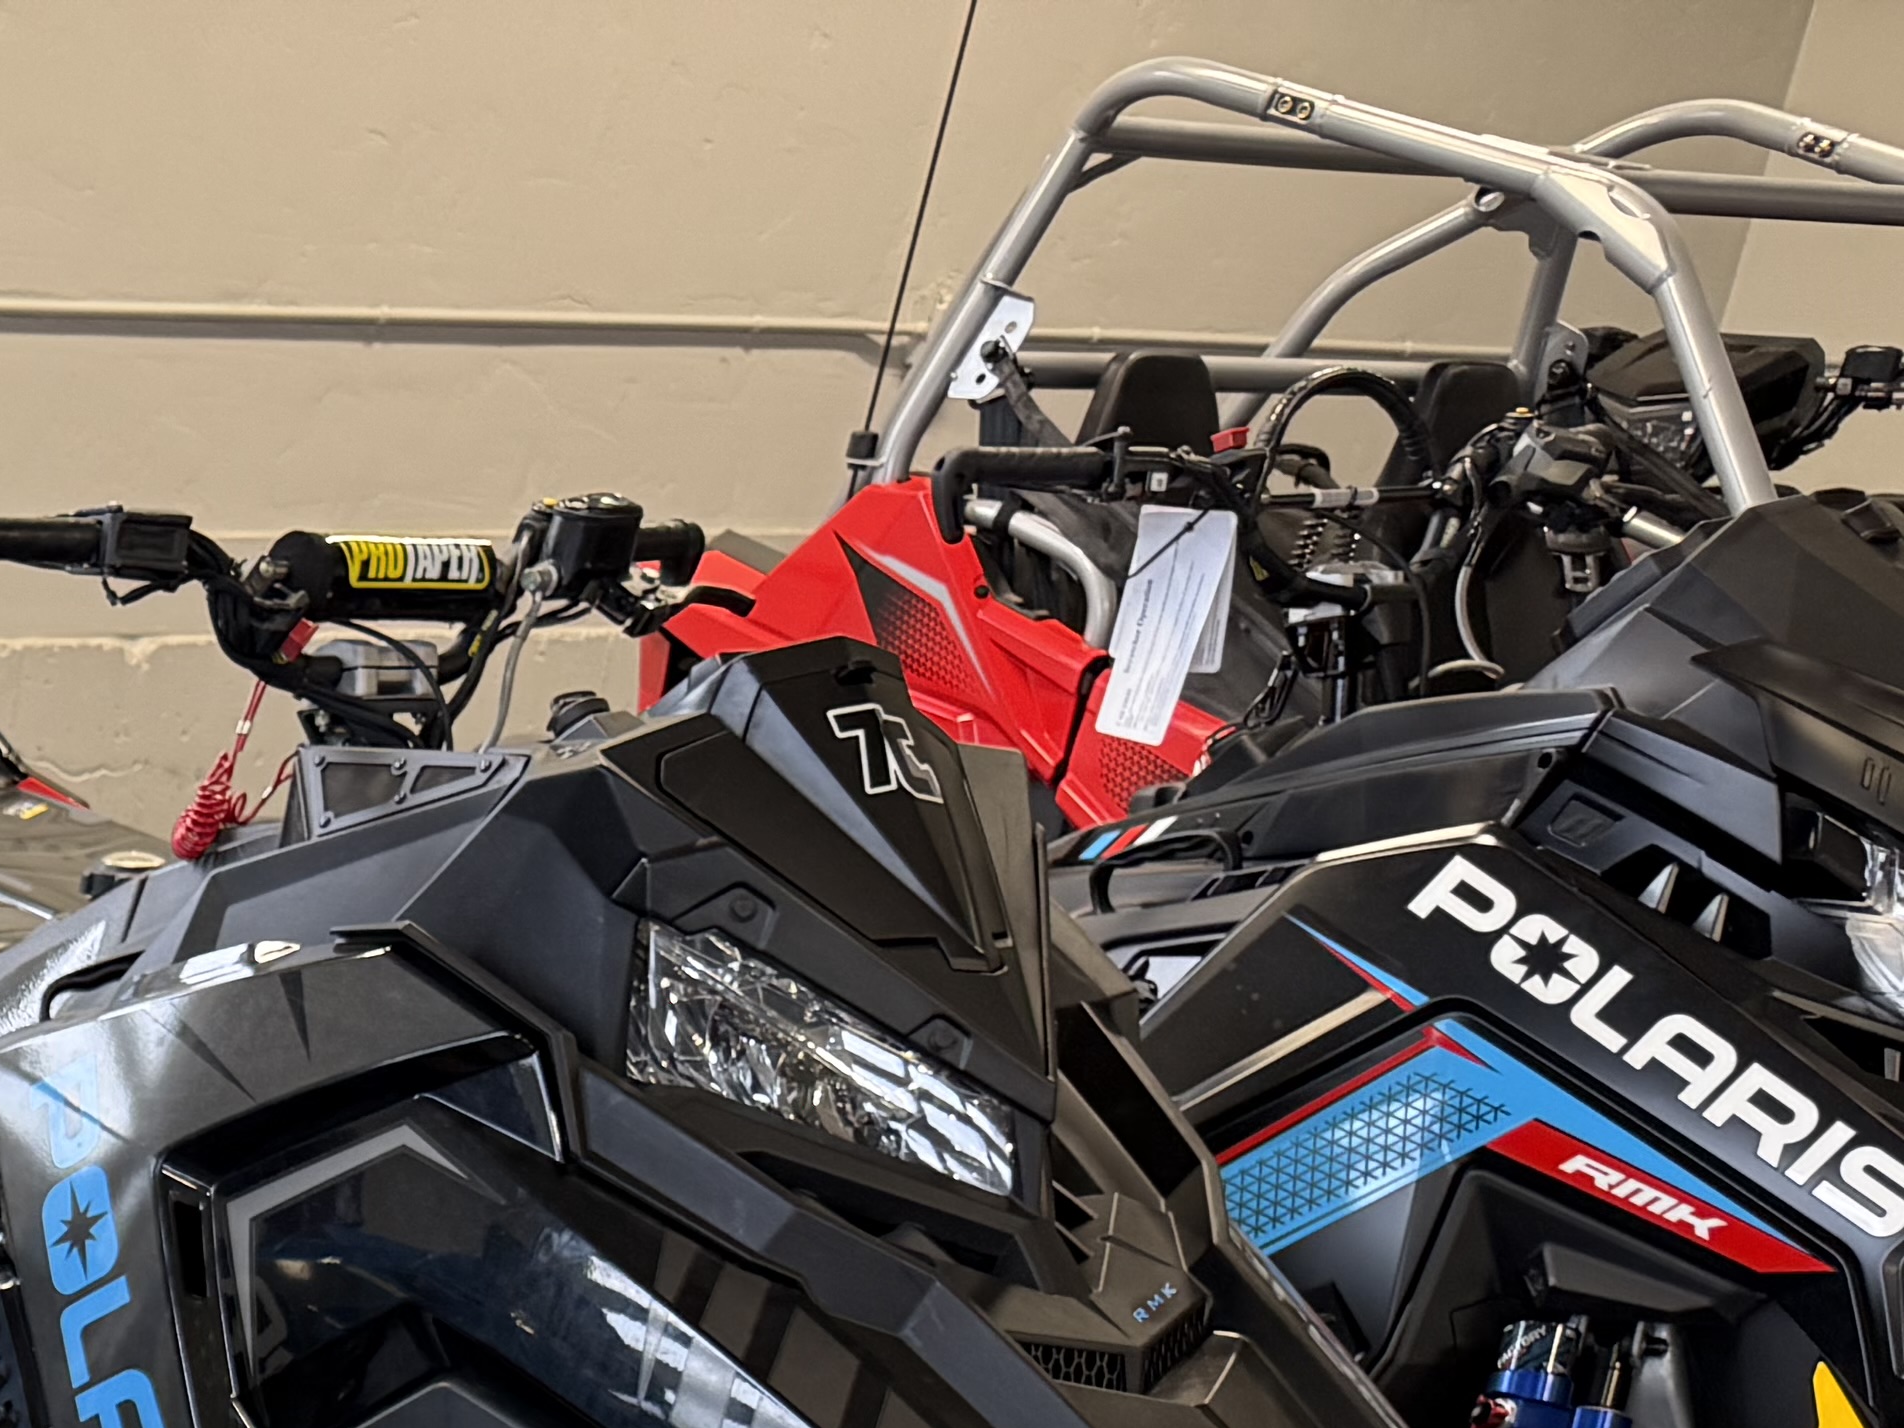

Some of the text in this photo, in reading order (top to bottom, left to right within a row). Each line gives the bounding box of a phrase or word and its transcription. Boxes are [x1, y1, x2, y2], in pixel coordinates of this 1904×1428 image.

[1407, 854, 1904, 1238] POLARIS
[1557, 1153, 1729, 1241] RMK
[1132, 1281, 1178, 1324] RMK
